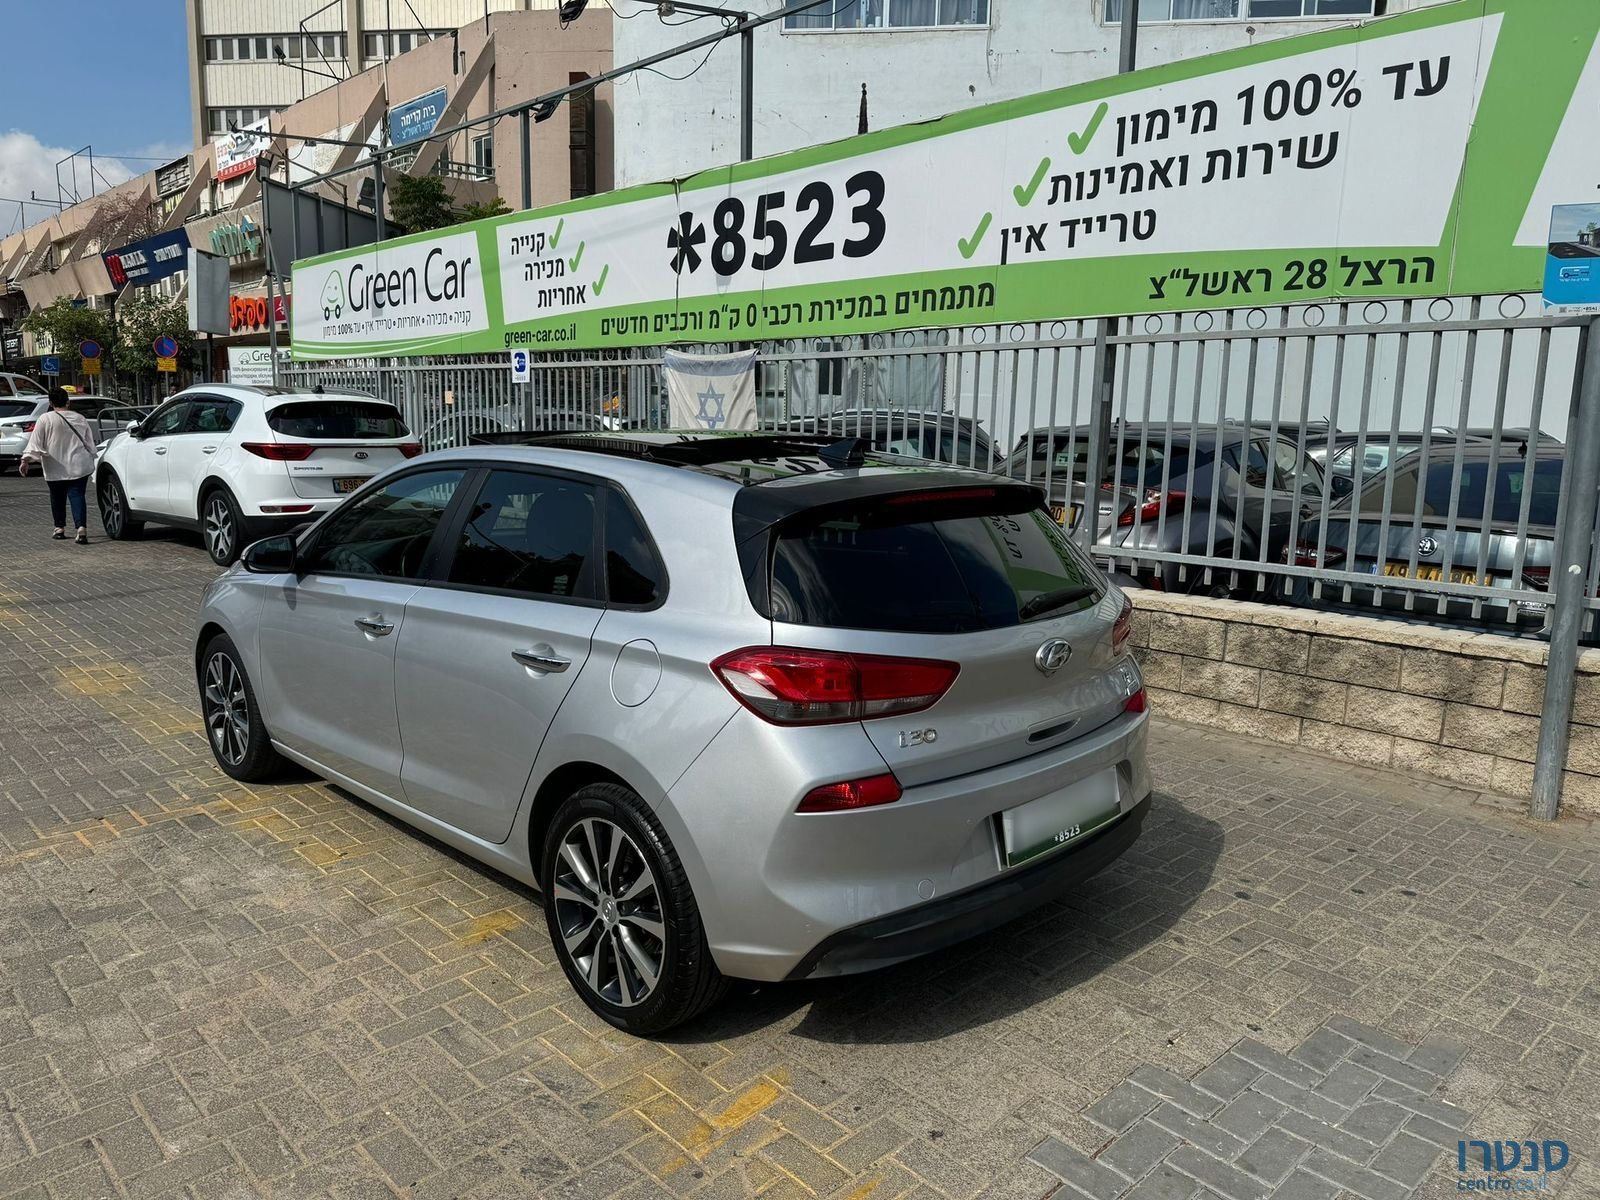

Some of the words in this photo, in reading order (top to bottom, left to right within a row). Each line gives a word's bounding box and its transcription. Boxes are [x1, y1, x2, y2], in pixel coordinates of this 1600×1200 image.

[1382, 56, 1451, 100] עד
[1237, 68, 1362, 126] 100%
[422, 105, 436, 118] בית
[1115, 99, 1218, 157] מימון
[1201, 131, 1340, 184] שירות
[1047, 154, 1189, 205] ואמינות
[1060, 209, 1156, 248] טרייד
[511, 232, 545, 257] קנייה
[1000, 222, 1049, 265] אין
[348, 263, 417, 312] Green
[424, 247, 471, 302] Car
[525, 258, 564, 281] מכירה
[1283, 258, 1328, 291] 28
[1340, 255, 1435, 287] הרצל
[1148, 267, 1272, 300] ראשל"צ
[538, 285, 586, 308] אחריות
[809, 295, 887, 322] במכירת
[895, 281, 995, 315] מתמחים
[375, 318, 392, 331] טרייד
[397, 316, 421, 329] אחריות
[426, 312, 448, 326] מכירה
[454, 310, 471, 326] קניה
[600, 314, 648, 336] חדשים
[653, 310, 703, 333] ורכבים
[709, 304, 740, 330] ק"מ
[746, 303, 757, 327] 0
[763, 302, 801, 326] רכבי
[323, 325, 337, 339] מימון
[338, 323, 353, 335] 100%
[353, 322, 361, 333] עד
[365, 320, 374, 335] אין
[504, 323, 576, 347] green-car.co.il
[898, 728, 938, 748] i30
